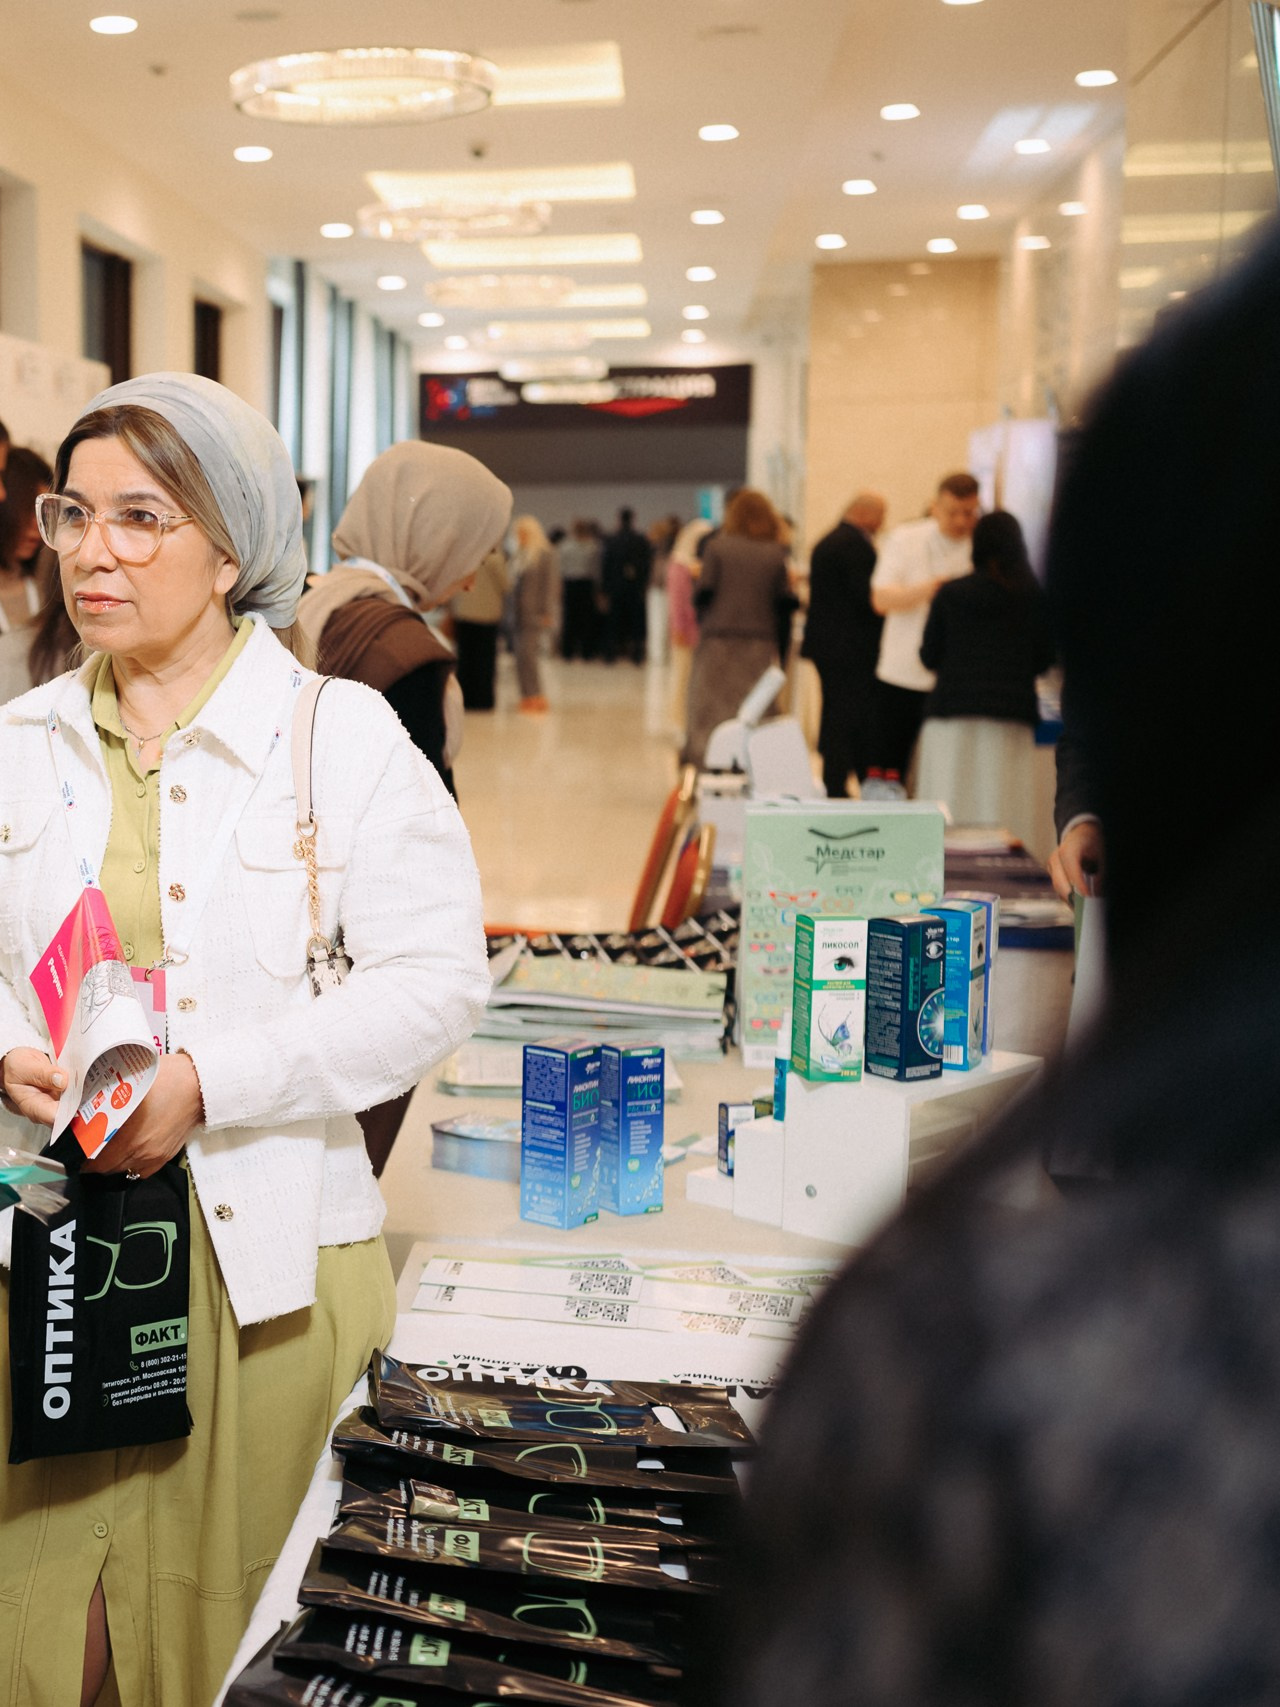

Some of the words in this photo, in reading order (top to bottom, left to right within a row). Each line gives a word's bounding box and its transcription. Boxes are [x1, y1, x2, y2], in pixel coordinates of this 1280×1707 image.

[816, 844, 886, 860] Медстар
[47, 957, 64, 999] Репринт
[42, 1219, 77, 1419] ОПТИКА
[145, 1358, 160, 1368] (800)
[452, 1354, 521, 1366] КЛИНИКА
[142, 1368, 177, 1380] Московская
[416, 1367, 616, 1396] ОПТИКА
[672, 1373, 744, 1383] КЛИНИКА
[110, 1390, 130, 1400] режим
[130, 1384, 153, 1395] работы
[152, 1379, 169, 1389] 08:00
[173, 1376, 187, 1385] 20:0
[111, 1397, 123, 1407] без
[123, 1393, 152, 1404] перерыва
